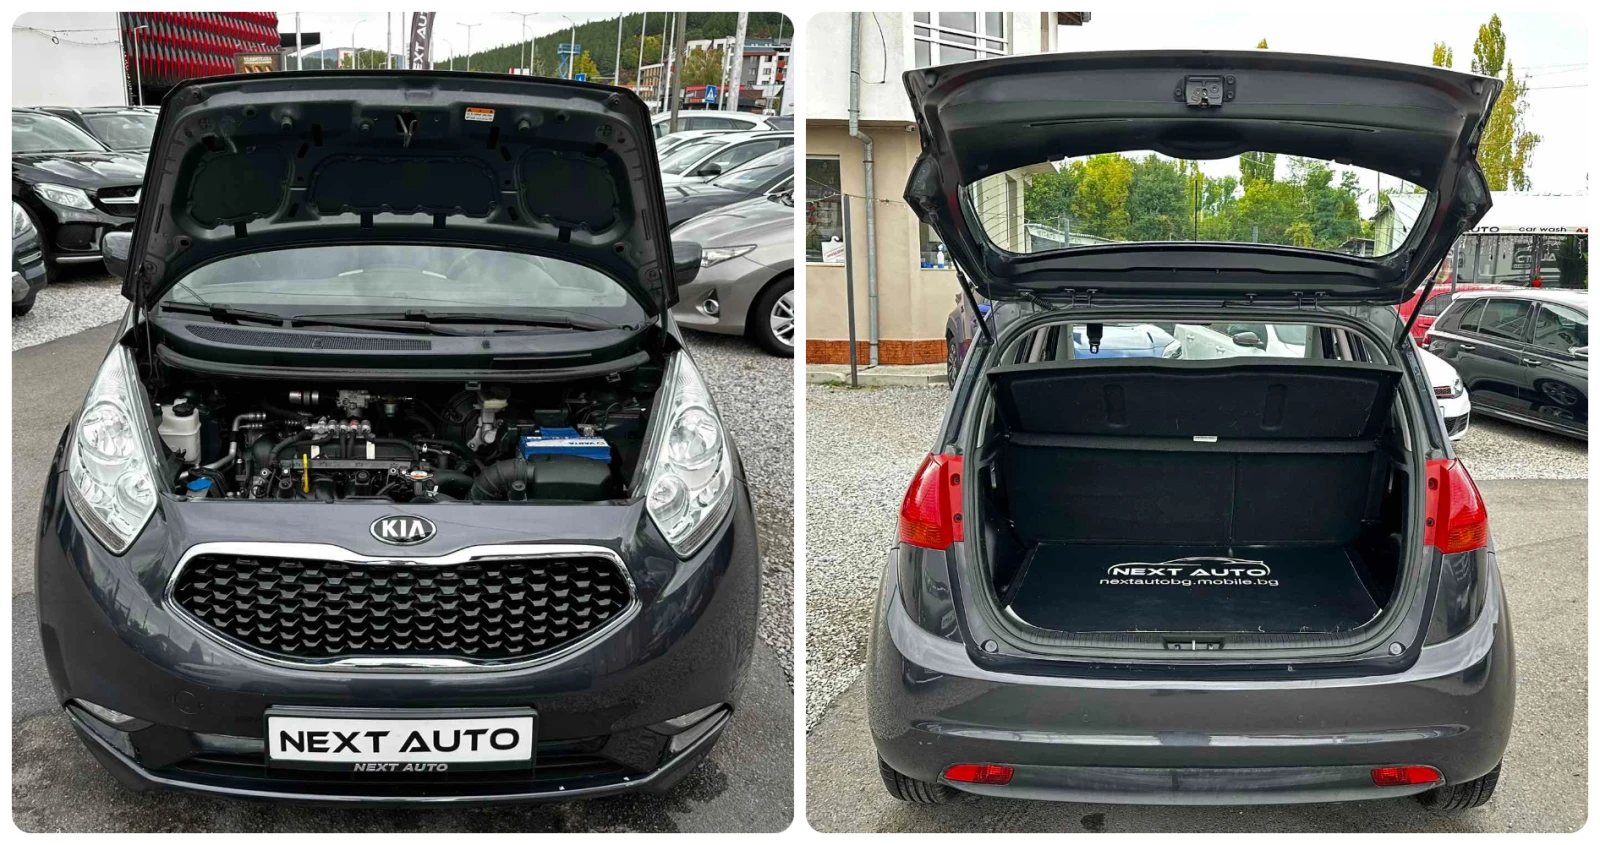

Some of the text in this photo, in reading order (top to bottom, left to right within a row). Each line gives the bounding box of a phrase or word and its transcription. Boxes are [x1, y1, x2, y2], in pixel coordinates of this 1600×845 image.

[412, 12, 428, 70] EXT AU
[381, 519, 426, 538] KIA
[1113, 567, 1267, 577] NEXT AUTO
[1099, 577, 1279, 587] nextautobg.mobile.bg
[280, 728, 520, 753] NEXT AUTO
[353, 763, 449, 772] NEXT AUTO
